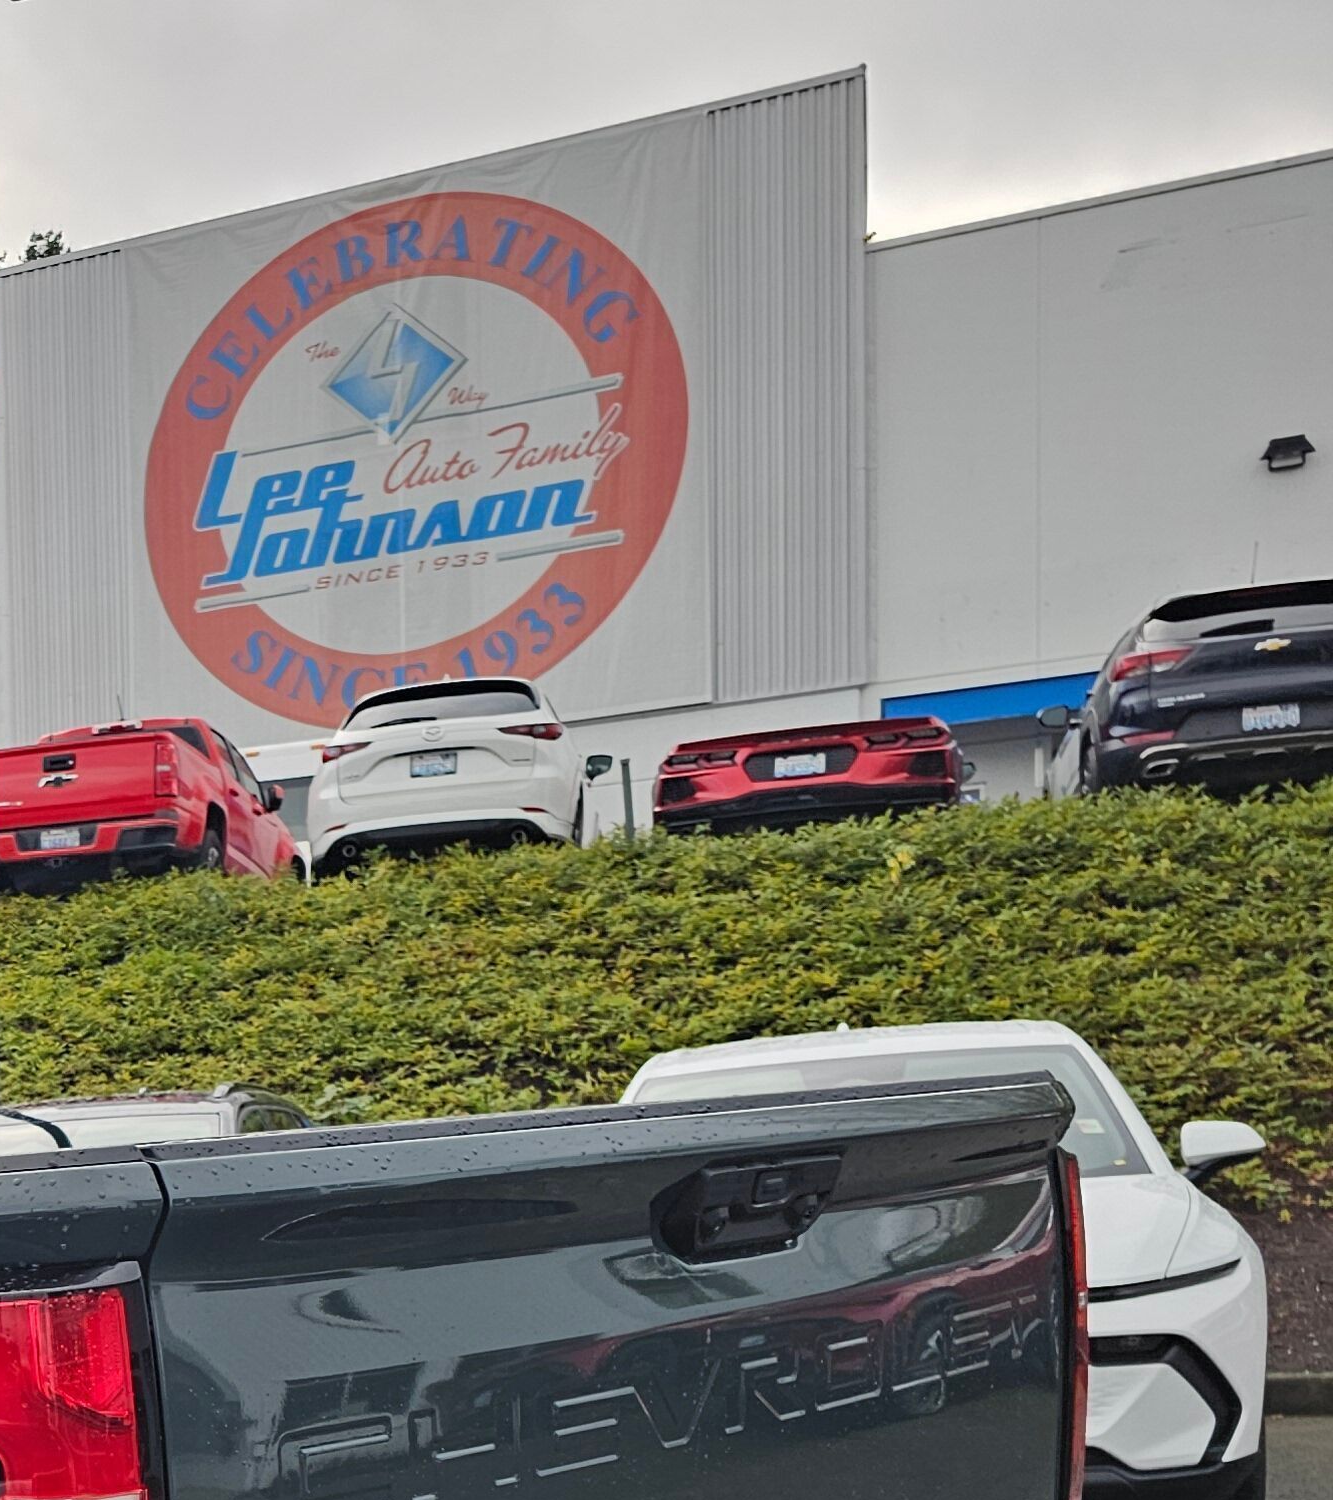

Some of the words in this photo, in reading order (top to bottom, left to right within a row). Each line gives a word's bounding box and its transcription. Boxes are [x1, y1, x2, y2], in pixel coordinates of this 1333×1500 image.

[184, 213, 642, 421] CELEBRATING
[304, 342, 340, 362] The
[448, 385, 489, 409] Way
[195, 450, 364, 530] Lee
[383, 439, 480, 495] Auto
[487, 402, 630, 478] Family
[202, 479, 597, 587] Johnson
[314, 565, 401, 591] SINCE
[417, 551, 490, 574] 1933
[453, 582, 587, 680] 1933
